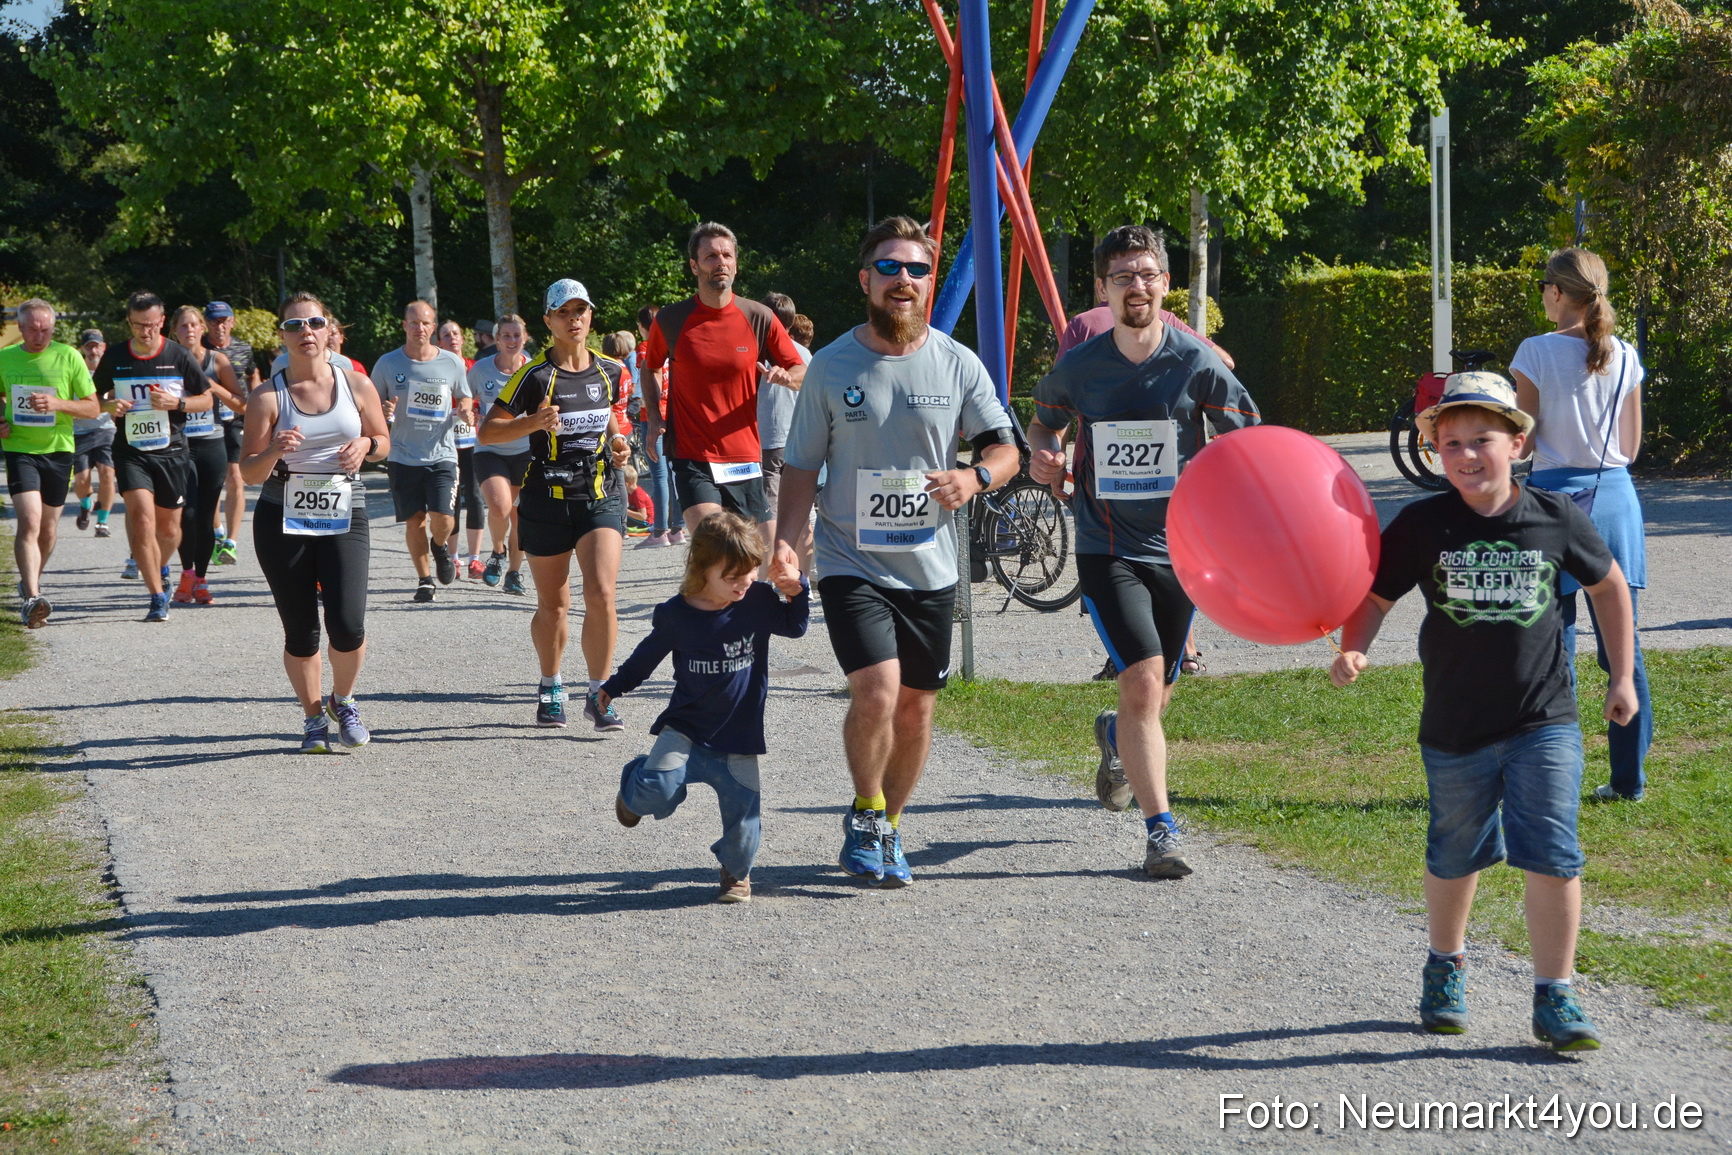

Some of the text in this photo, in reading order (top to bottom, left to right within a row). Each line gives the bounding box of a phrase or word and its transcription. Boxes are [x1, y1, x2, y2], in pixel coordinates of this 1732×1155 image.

[414, 392, 442, 406] 2996
[908, 396, 950, 405] BOCK
[845, 410, 867, 418] PARTL
[131, 421, 161, 435] 2061
[1117, 429, 1152, 437] BOCK
[1107, 443, 1164, 467] 2327
[882, 478, 919, 487] BOCK
[1114, 480, 1159, 491] Bernhard
[293, 491, 341, 510] 2957
[869, 493, 929, 518] 2052
[303, 520, 331, 529] Nadine
[886, 533, 915, 544] Heiko
[1439, 550, 1544, 566] RIGID CONTROL
[688, 659, 719, 674] LITTLE
